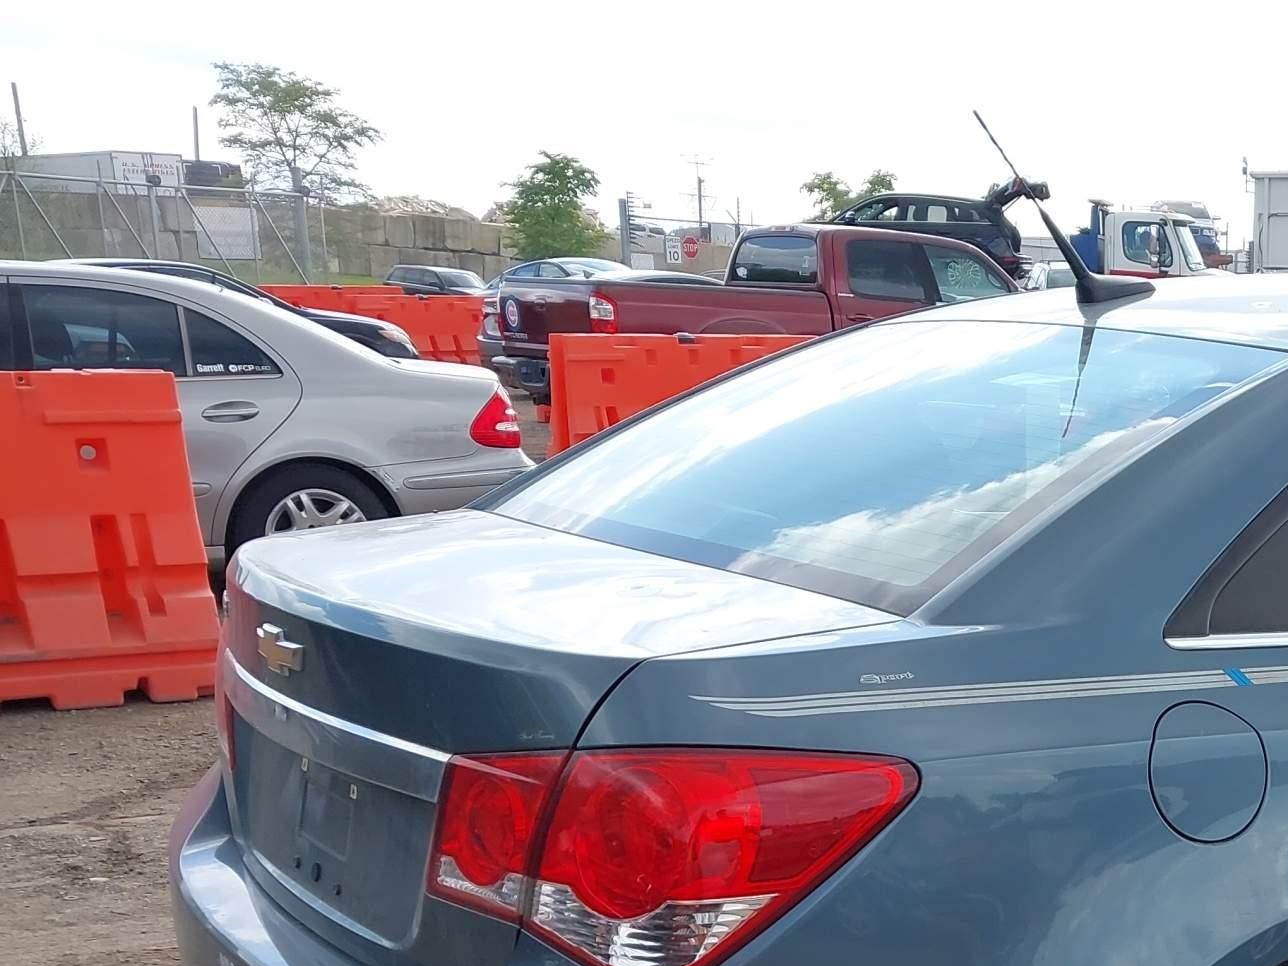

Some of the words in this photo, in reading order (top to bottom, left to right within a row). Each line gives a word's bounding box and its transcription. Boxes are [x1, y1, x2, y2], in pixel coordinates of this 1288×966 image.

[683, 243, 698, 252] STOP
[669, 250, 680, 262] 10
[860, 671, 915, 684] Sport
